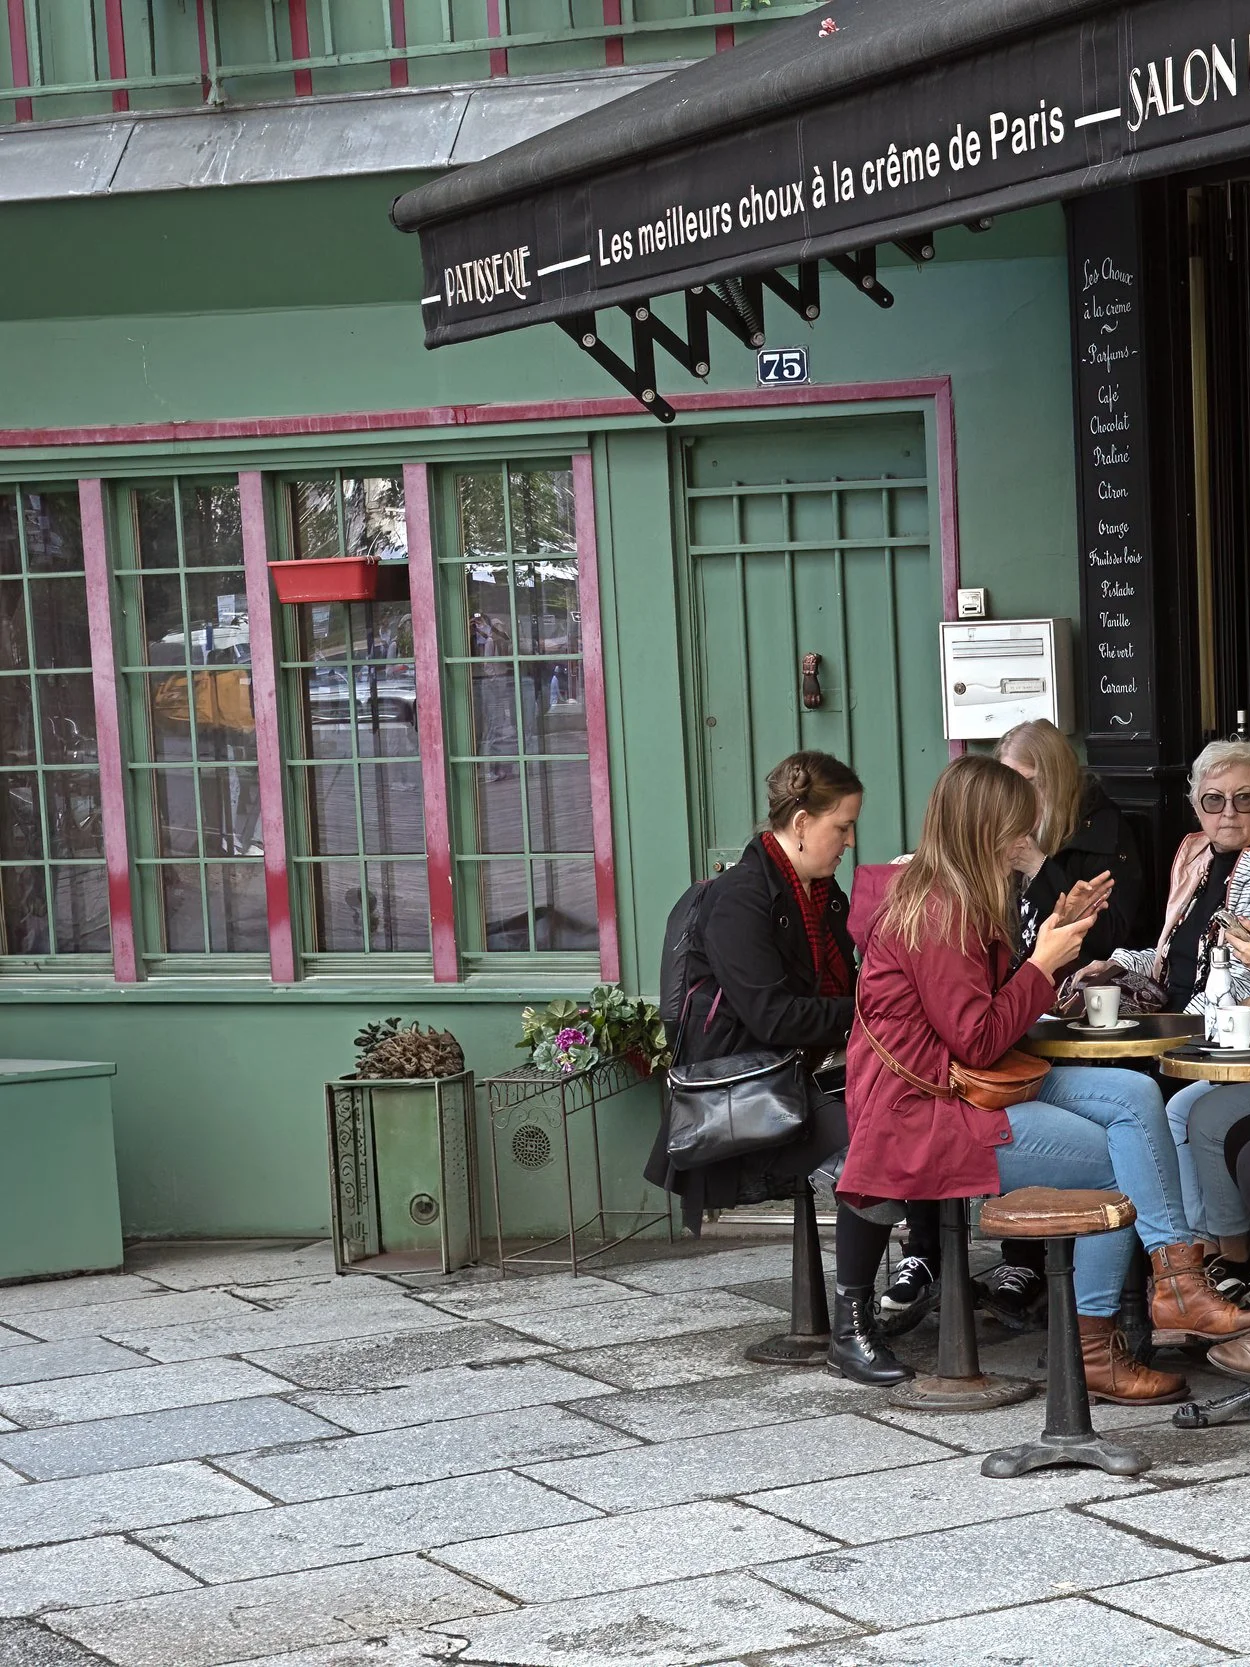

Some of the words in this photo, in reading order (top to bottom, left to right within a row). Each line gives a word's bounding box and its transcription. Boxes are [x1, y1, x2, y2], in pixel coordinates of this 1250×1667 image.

[444, 245, 531, 306] PATISSERIE
[598, 228, 632, 266] Les
[638, 202, 731, 255] meilleurs
[738, 180, 804, 228] choux
[811, 165, 826, 208] à
[832, 160, 854, 202] la
[948, 123, 980, 170] de
[989, 99, 1064, 159] Paris
[1126, 38, 1236, 132] SALON
[1082, 258, 1099, 291] Les
[1101, 256, 1133, 285] Choux
[1083, 302, 1091, 319] à
[1092, 295, 1104, 317] la
[762, 353, 802, 381] 75
[1097, 383, 1119, 412] Café
[1089, 411, 1129, 434] Chocolat
[1093, 443, 1129, 466] Praliné
[1098, 480, 1126, 499] Citron
[1098, 519, 1129, 538] Orange
[1088, 547, 1112, 566] Fruits
[1112, 553, 1122, 564] des
[1123, 545, 1142, 563] bois
[1100, 579, 1134, 598] Pistache
[1099, 611, 1130, 627] Vanille
[1098, 642, 1116, 658] Thé
[1116, 642, 1133, 658] vert
[1100, 674, 1137, 693] Caramel
